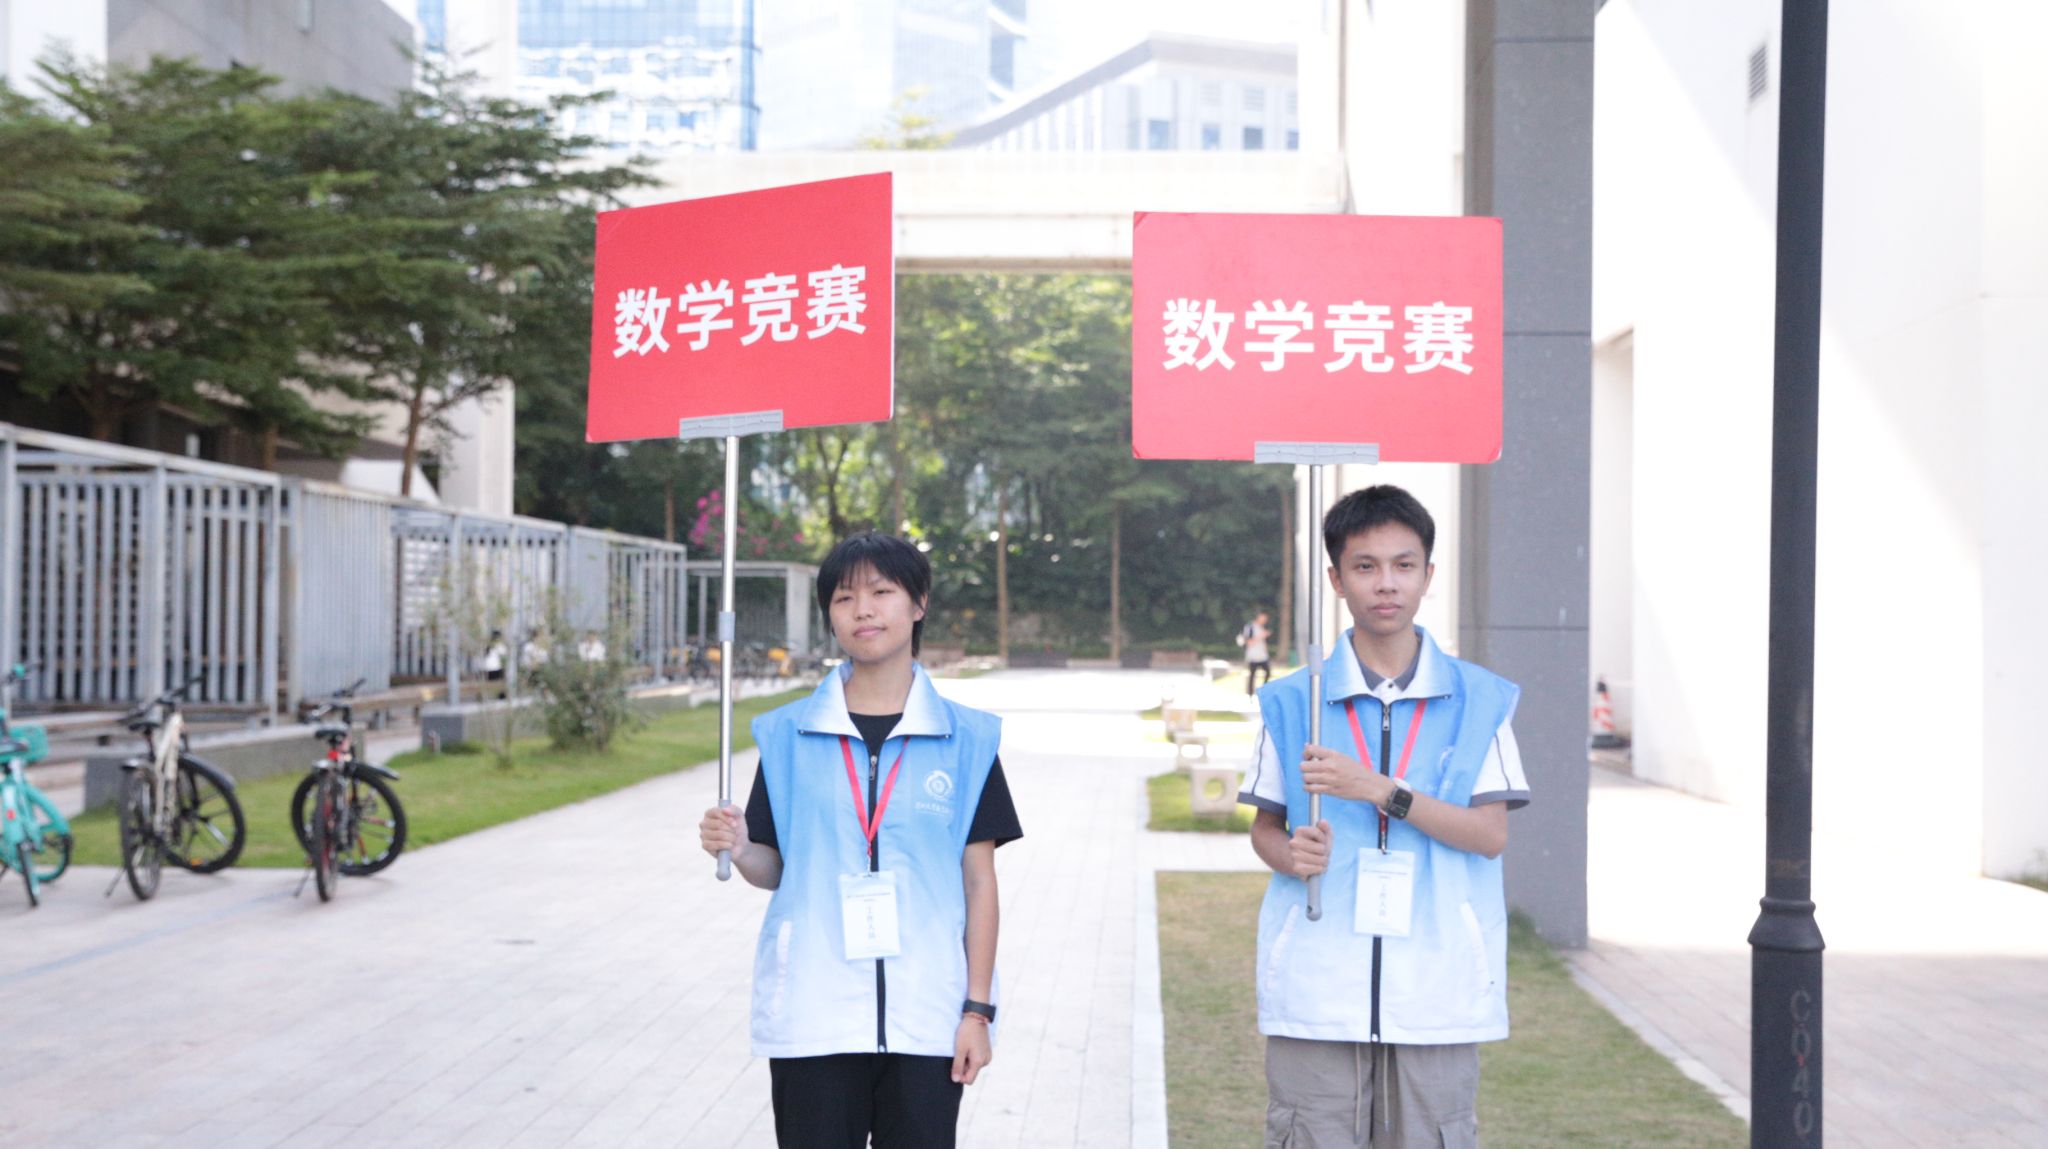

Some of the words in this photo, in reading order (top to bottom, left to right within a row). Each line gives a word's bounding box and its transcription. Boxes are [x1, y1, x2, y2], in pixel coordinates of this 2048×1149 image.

[613, 263, 867, 359] 数学竞赛
[1162, 297, 1475, 375] 数学竞赛
